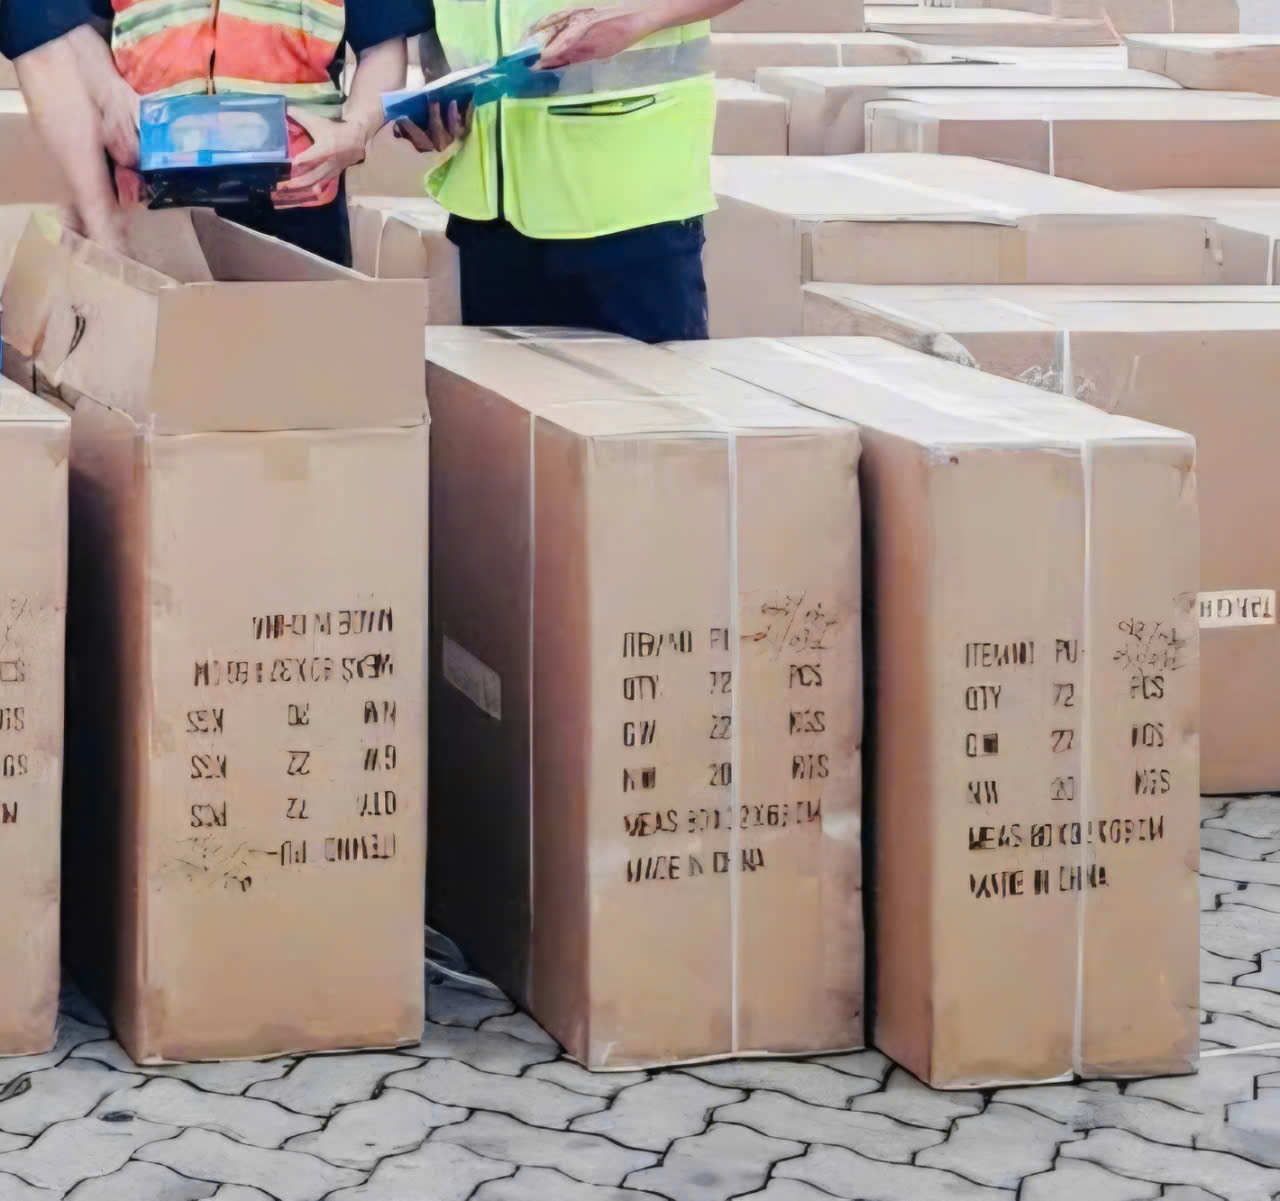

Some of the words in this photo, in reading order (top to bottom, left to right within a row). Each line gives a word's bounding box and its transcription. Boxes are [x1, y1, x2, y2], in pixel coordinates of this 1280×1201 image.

[1054, 683, 1074, 707] 72
[710, 714, 731, 739] 22
[286, 751, 310, 775] 22
[710, 762, 731, 786] 20
[286, 798, 309, 820] 72
